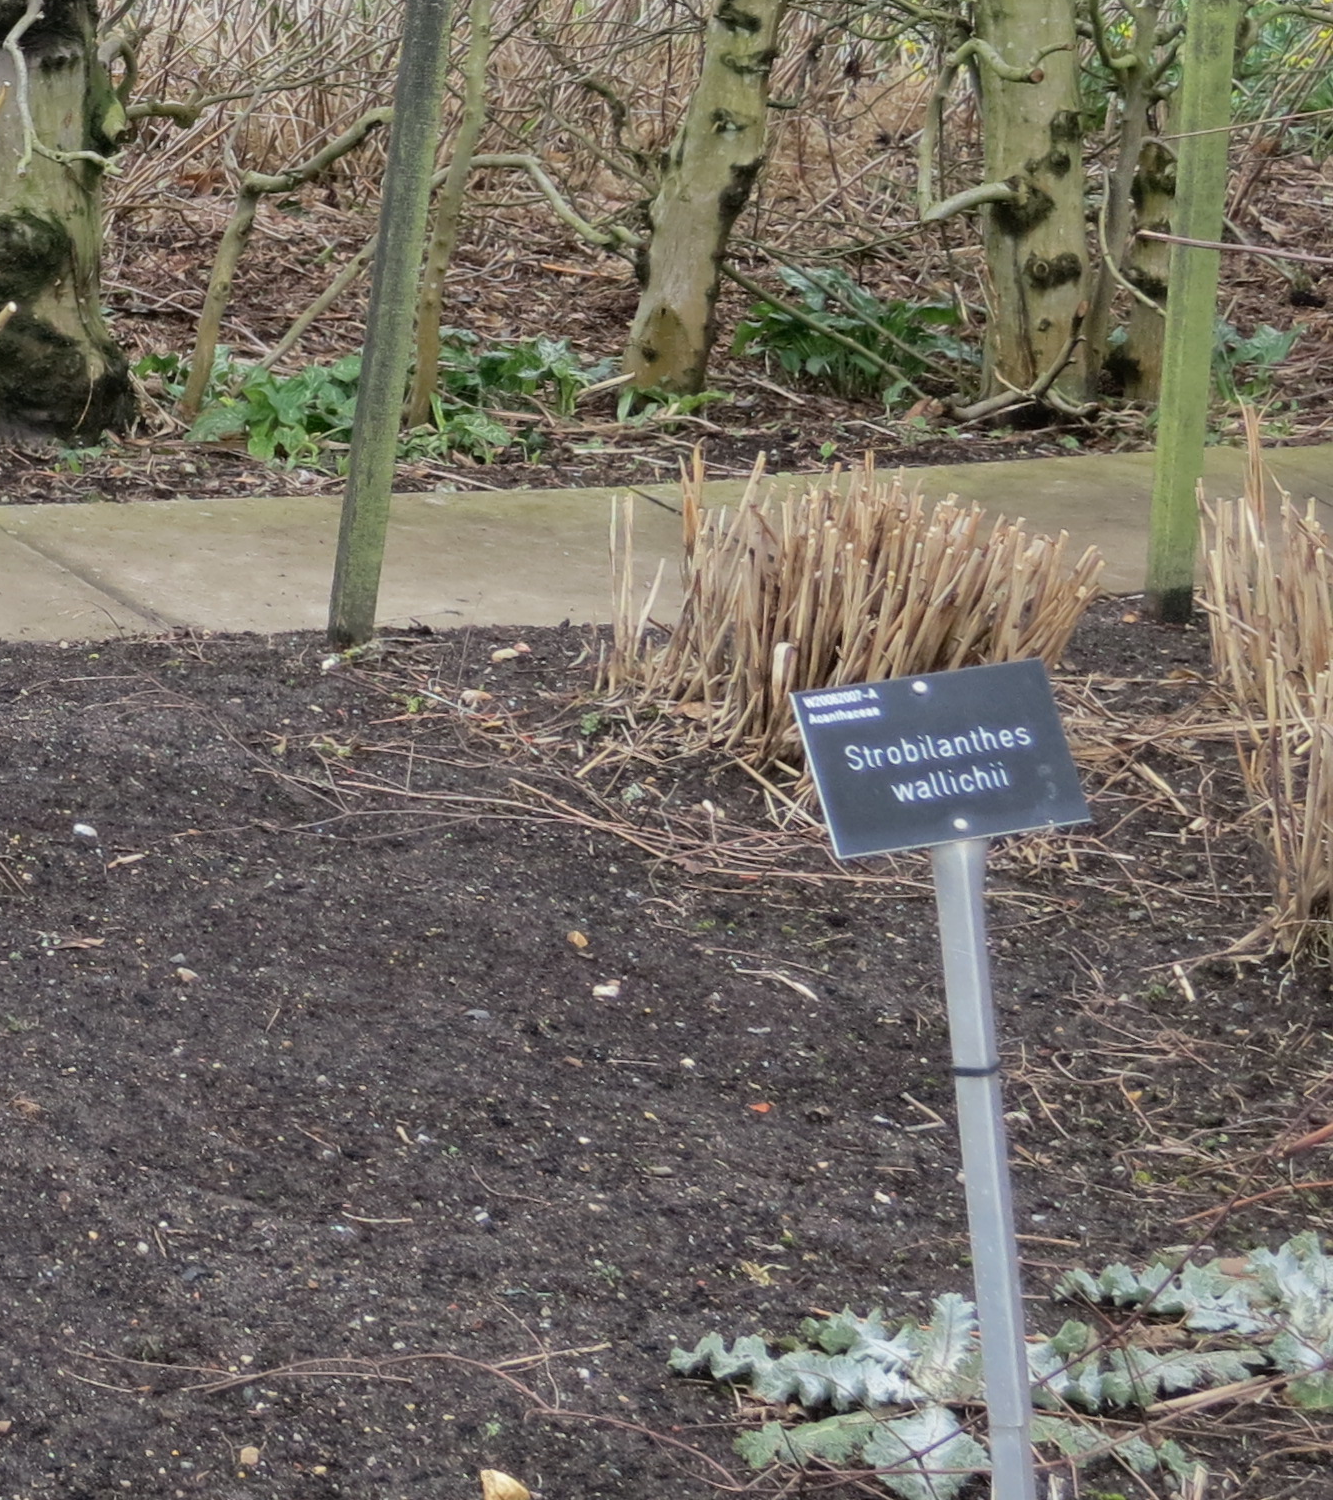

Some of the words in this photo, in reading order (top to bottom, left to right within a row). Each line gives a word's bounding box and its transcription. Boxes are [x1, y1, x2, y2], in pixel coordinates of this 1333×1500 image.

[808, 706, 881, 725] Acanthaceae
[844, 725, 1032, 772] Strobilanthes
[890, 761, 1010, 803] wallichii
